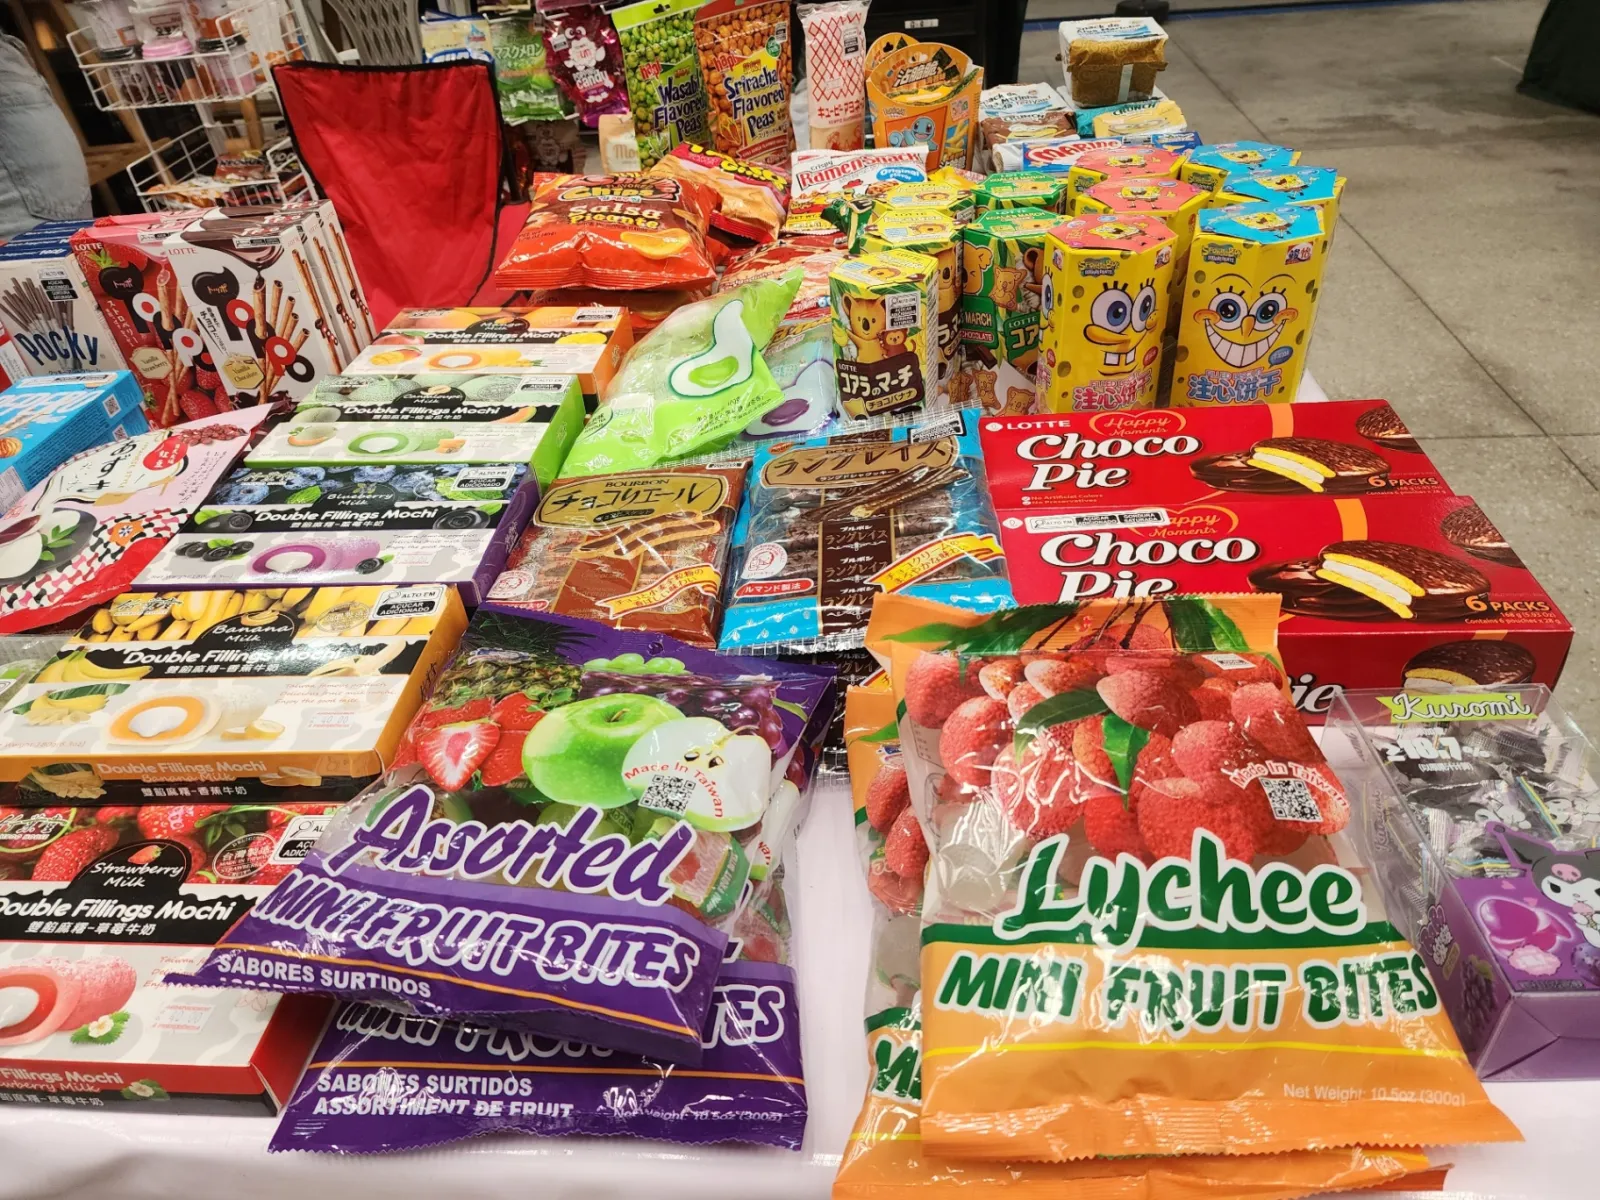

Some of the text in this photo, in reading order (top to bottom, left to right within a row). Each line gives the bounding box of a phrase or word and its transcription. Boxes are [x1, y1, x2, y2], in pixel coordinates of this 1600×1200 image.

[494, 44, 544, 58] マスクメロン
[659, 73, 700, 105] Wasabi
[723, 66, 779, 100] Sriracha
[733, 85, 786, 120] Flavored
[1113, 102, 1158, 116] CRUNCH
[654, 96, 705, 128] Flavored
[676, 116, 702, 142] Peas
[747, 110, 775, 139] Peas
[74, 243, 103, 251] LOTTE
[965, 312, 992, 326] MARCH
[1009, 316, 1037, 328] LOTTE
[425, 331, 562, 340] Double Fillings Mochi
[960, 330, 992, 341] CHOCOLATE
[840, 364, 914, 397] コアラのマーチ
[869, 389, 915, 409] チョコバナナ
[344, 405, 500, 416] Double Fillings Mochi
[1007, 420, 1071, 430] LOTTE
[1104, 415, 1171, 429] Happy
[1109, 427, 1169, 437] Moments
[1016, 432, 1203, 461] Choco
[605, 479, 670, 488] BOURBON
[1021, 462, 1131, 492] Pie
[1368, 475, 1439, 487] 6 PACKS
[327, 492, 394, 500] Blueberry
[255, 508, 439, 522] Double Fillings Mochi
[1169, 513, 1221, 526] appy
[825, 530, 888, 545] ラングレイス
[1149, 526, 1217, 538] Moments
[1040, 532, 1261, 567] Choco
[745, 582, 801, 593] ルマンド製法
[380, 606, 430, 615] ADICIONADO
[389, 602, 424, 610] AÇUCAR
[1465, 595, 1551, 612] 6 PACKS
[212, 623, 294, 634] Banana
[123, 647, 342, 664] Double Fillings Mochi
[1289, 673, 1345, 715] ie
[1392, 692, 1532, 721] Kuromi
[97, 760, 266, 775] Double Fillings Mochi
[141, 773, 236, 783] Banana Milk
[1229, 759, 1351, 808] Made In Taiwan
[624, 761, 724, 818] Made In Taiwan
[327, 782, 696, 907] Assorted
[91, 861, 184, 878] Strawberry
[103, 876, 146, 888] Milk
[993, 828, 1368, 955] Lychee
[71, 898, 154, 920] Fillings
[154, 900, 236, 920] Mochi
[250, 869, 701, 995] MINI FRUIT BITES
[218, 954, 315, 984] SABORES
[319, 969, 432, 999] SURTIDOS
[934, 949, 1441, 1036] MINI FRUIT BITES
[65, 1071, 125, 1085] Mochi
[317, 1073, 534, 1097] SABORES SURTIDOS
[60, 1082, 101, 1094] Milk
[1283, 1083, 1466, 1107] Net Weight: 10.5oz (300g)
[312, 1097, 574, 1118] ASSORTIMENT DE FRUIT
